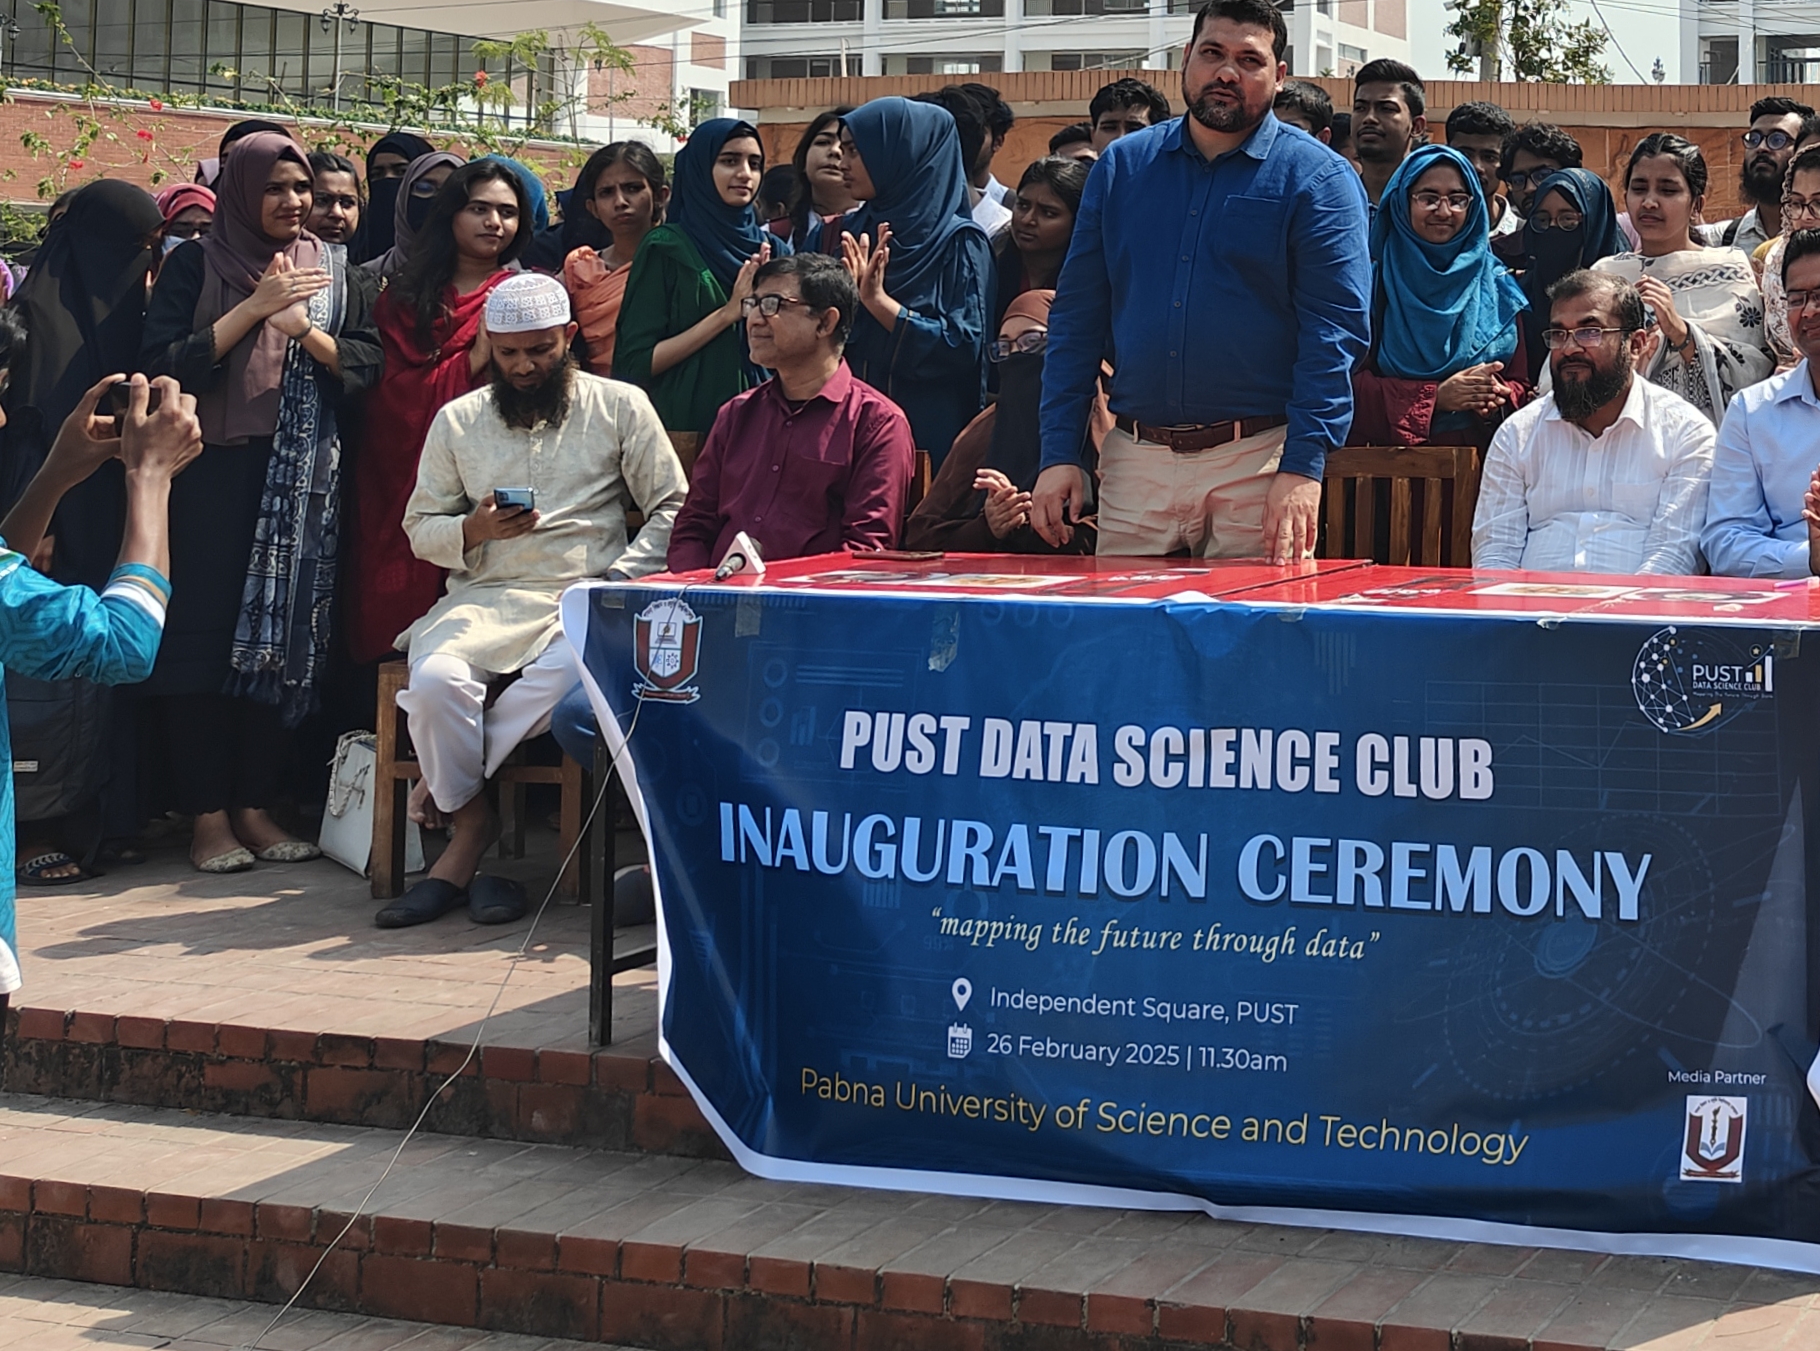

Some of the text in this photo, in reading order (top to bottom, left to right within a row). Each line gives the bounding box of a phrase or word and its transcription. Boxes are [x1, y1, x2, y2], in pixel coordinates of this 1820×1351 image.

[1693, 665, 1743, 682] PUST
[1714, 682, 1742, 690] SCIENCE
[1744, 683, 1761, 691] CLUB
[841, 711, 1493, 799] PUST DATA SCIENCE CLUB
[720, 803, 1651, 920] INAUGURATION CEREMONY
[1053, 917, 1090, 945] the
[1092, 920, 1182, 955] future
[1193, 923, 1296, 962] through
[991, 987, 1299, 1024] Independent Square, PUST
[988, 1034, 1012, 1054] 26
[1019, 1036, 1120, 1066] February
[1126, 1044, 1179, 1065] 2025
[1199, 1047, 1286, 1071] 11.30am
[1669, 1071, 1766, 1084] Media Partner
[803, 1068, 1528, 1164] Pabna University of Science and Technology
